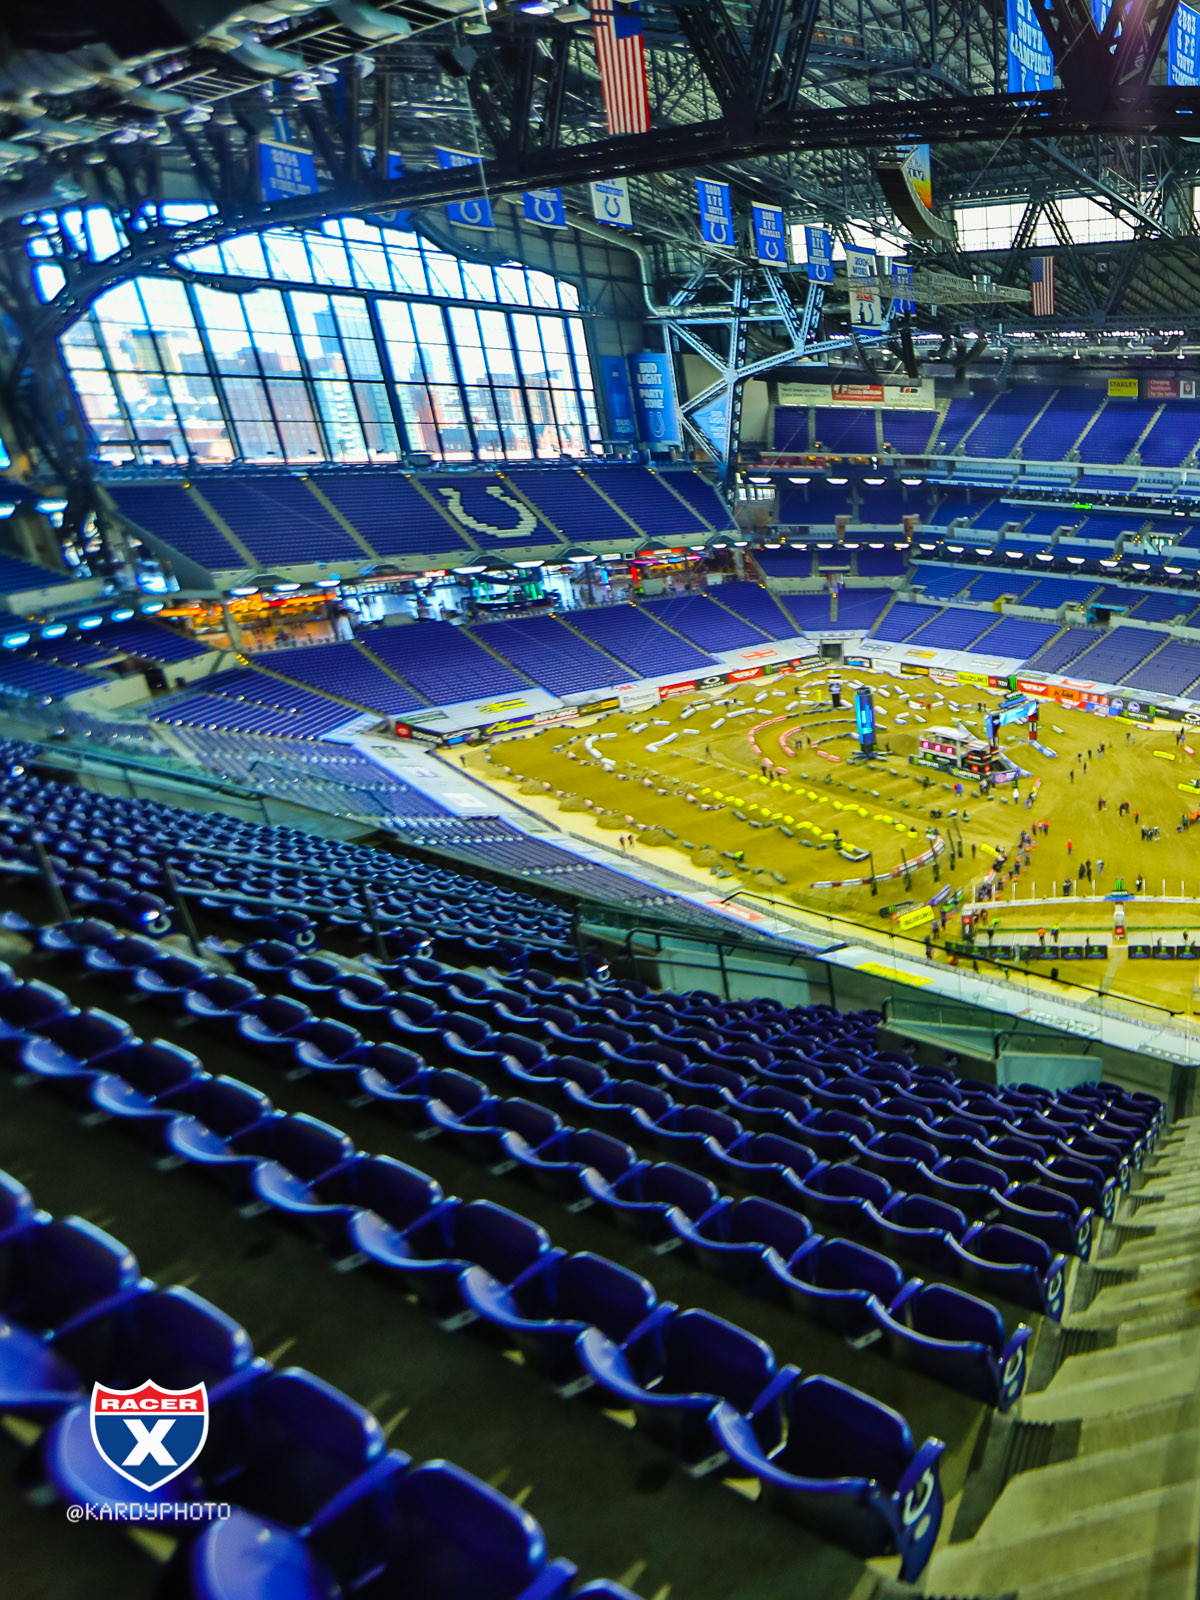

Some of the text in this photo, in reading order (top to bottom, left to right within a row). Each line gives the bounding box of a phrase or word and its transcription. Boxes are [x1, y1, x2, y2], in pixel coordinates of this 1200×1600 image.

[1018, 16, 1043, 52] SOUTH
[1177, 28, 1195, 57] AFC
[1011, 31, 1051, 76] CHAMPIONS
[1176, 51, 1195, 75] SOUTH
[639, 363, 658, 373] BUD
[637, 374, 662, 385] LIGHT
[640, 389, 664, 399] PARTY
[644, 399, 664, 409] ZONE
[959, 673, 988, 684] SUZUKI
[668, 684, 695, 695] HONDA
[411, 729, 444, 744] TOYOTA
[904, 911, 933, 926] SUZUKI
